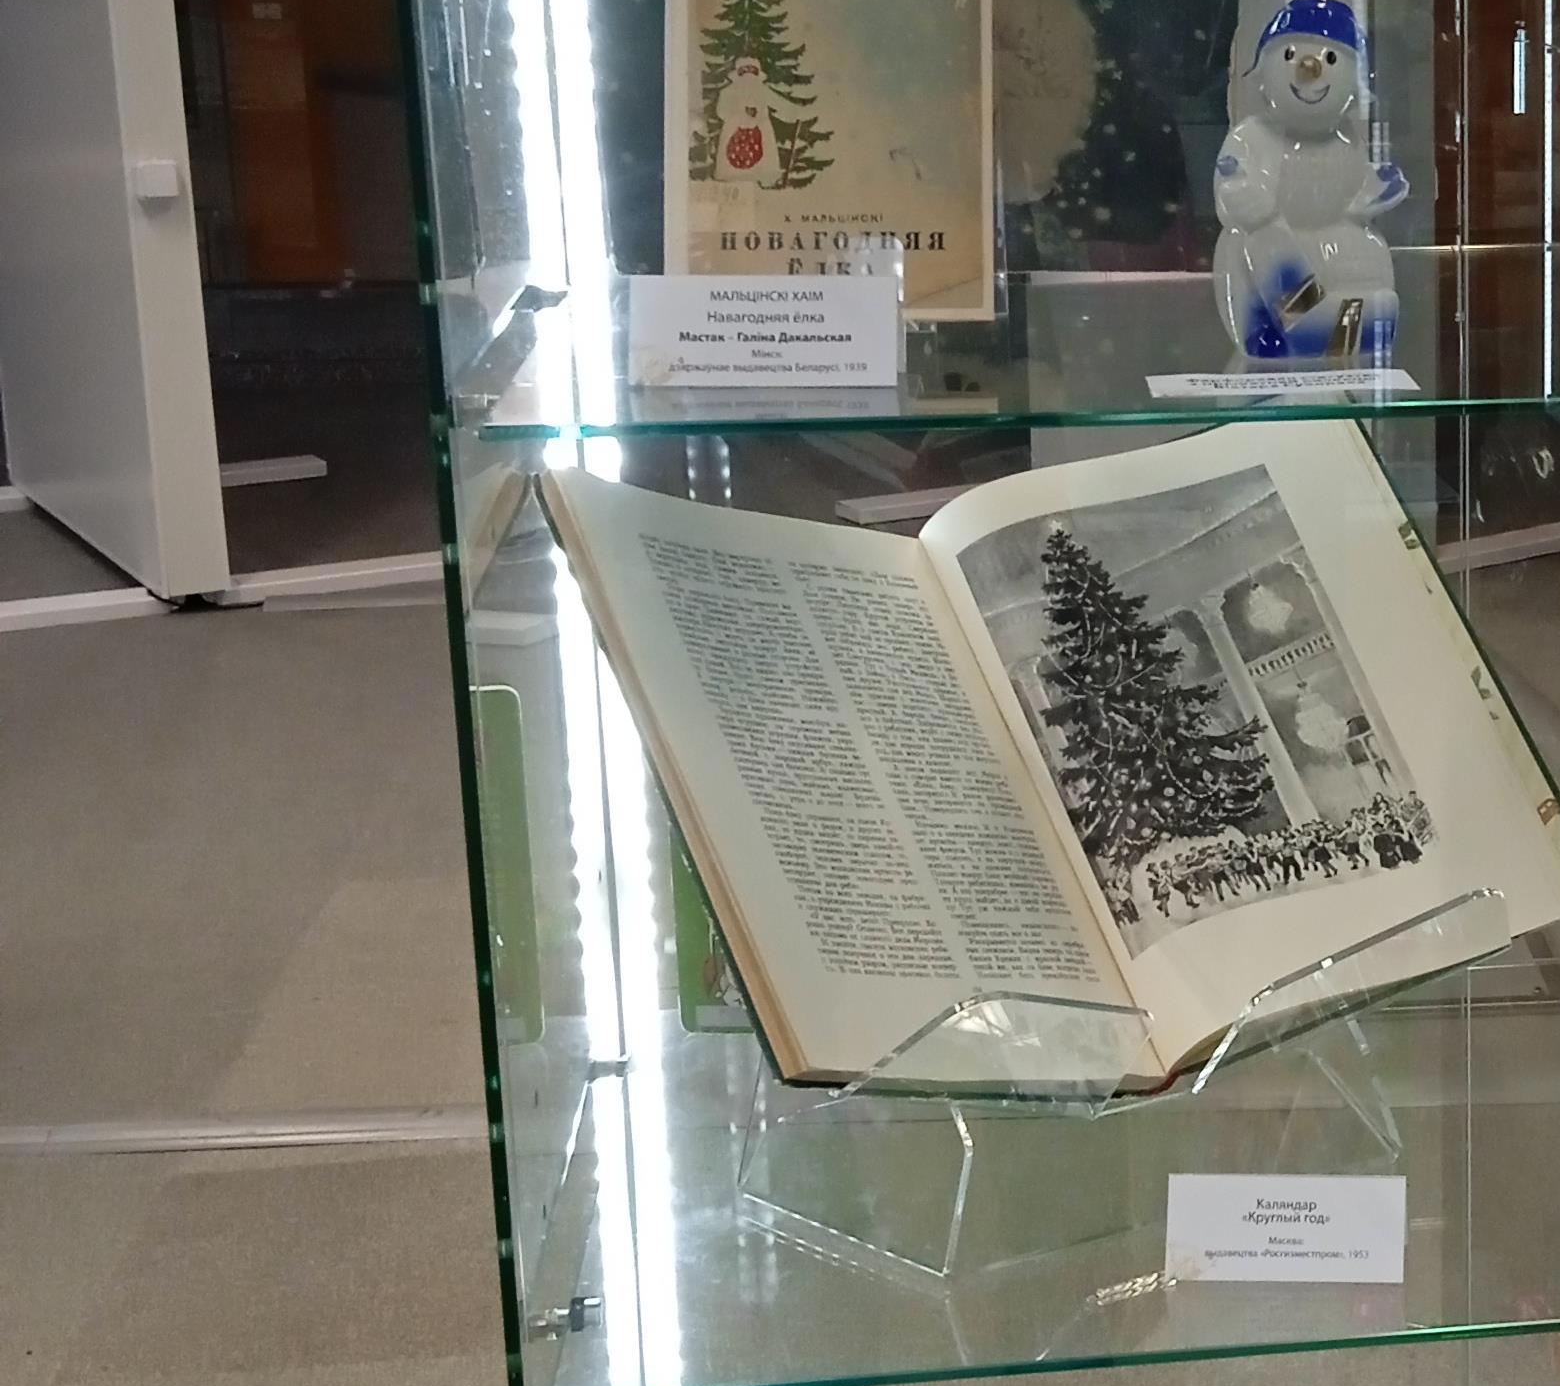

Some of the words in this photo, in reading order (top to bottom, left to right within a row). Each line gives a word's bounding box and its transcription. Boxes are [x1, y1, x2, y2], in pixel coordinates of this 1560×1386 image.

[720, 231, 946, 254] НОВАГОДНЯЯ
[709, 290, 789, 304] МАЛЬЦІНСКІ
[792, 290, 824, 302] ХАІМ
[706, 311, 790, 324] Навагодняя
[793, 310, 825, 323] ёлка
[678, 331, 726, 343] Мастак
[737, 331, 776, 343] Галіна
[1256, 1198, 1318, 1213] Каляндар
[1242, 1211, 1301, 1225] «Круглый
